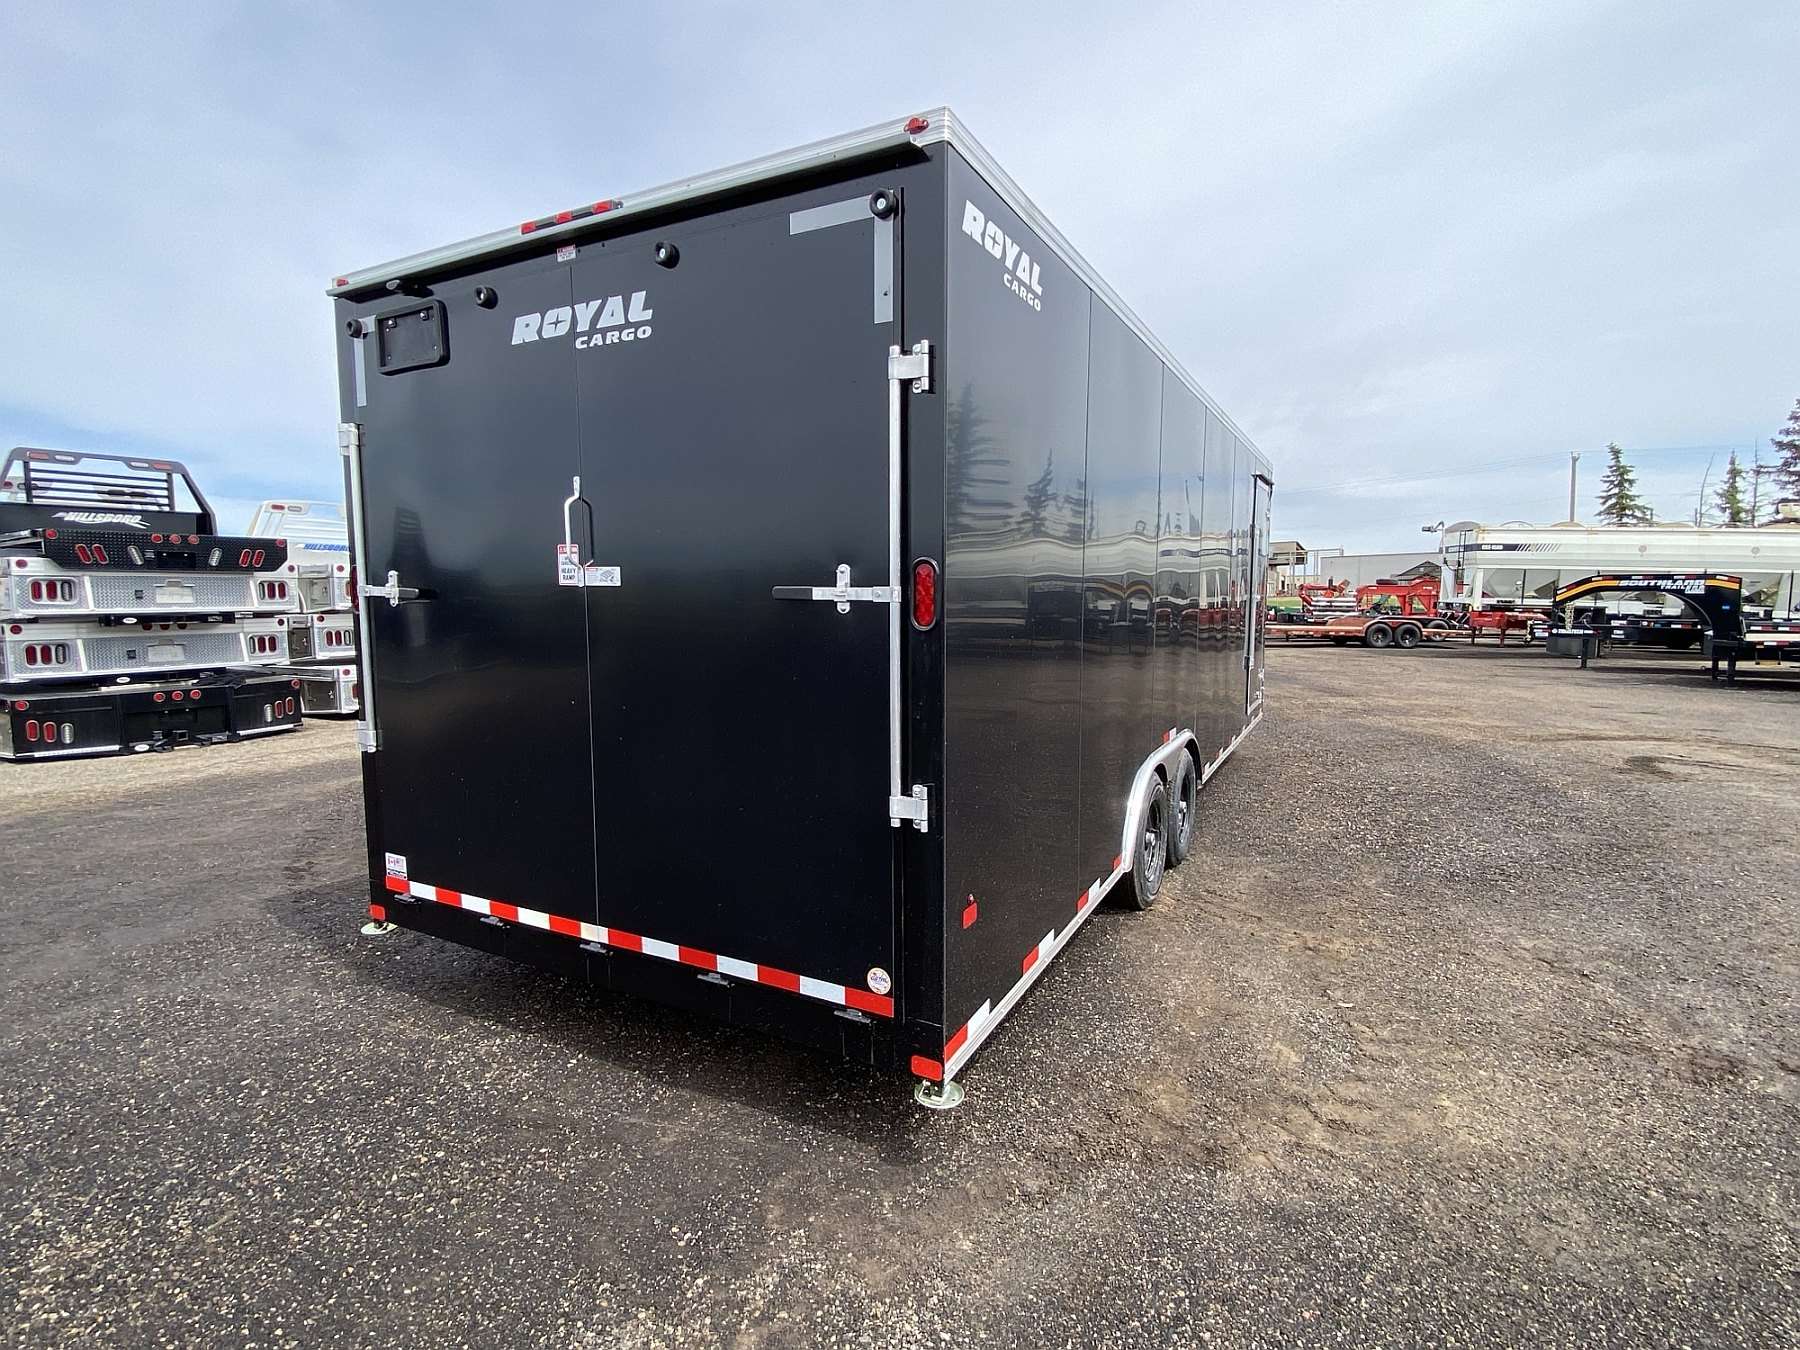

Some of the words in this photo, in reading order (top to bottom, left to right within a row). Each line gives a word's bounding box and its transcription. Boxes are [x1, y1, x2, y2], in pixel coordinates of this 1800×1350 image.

[962, 199, 1043, 297] ROYAL
[1003, 272, 1041, 312] CARGO
[511, 290, 653, 346] ROYAL
[575, 325, 653, 349] CARGO
[63, 511, 143, 524] HILLSBORO
[303, 543, 349, 552] HILLSBOR
[1618, 579, 1706, 587] SOUTHLAND
